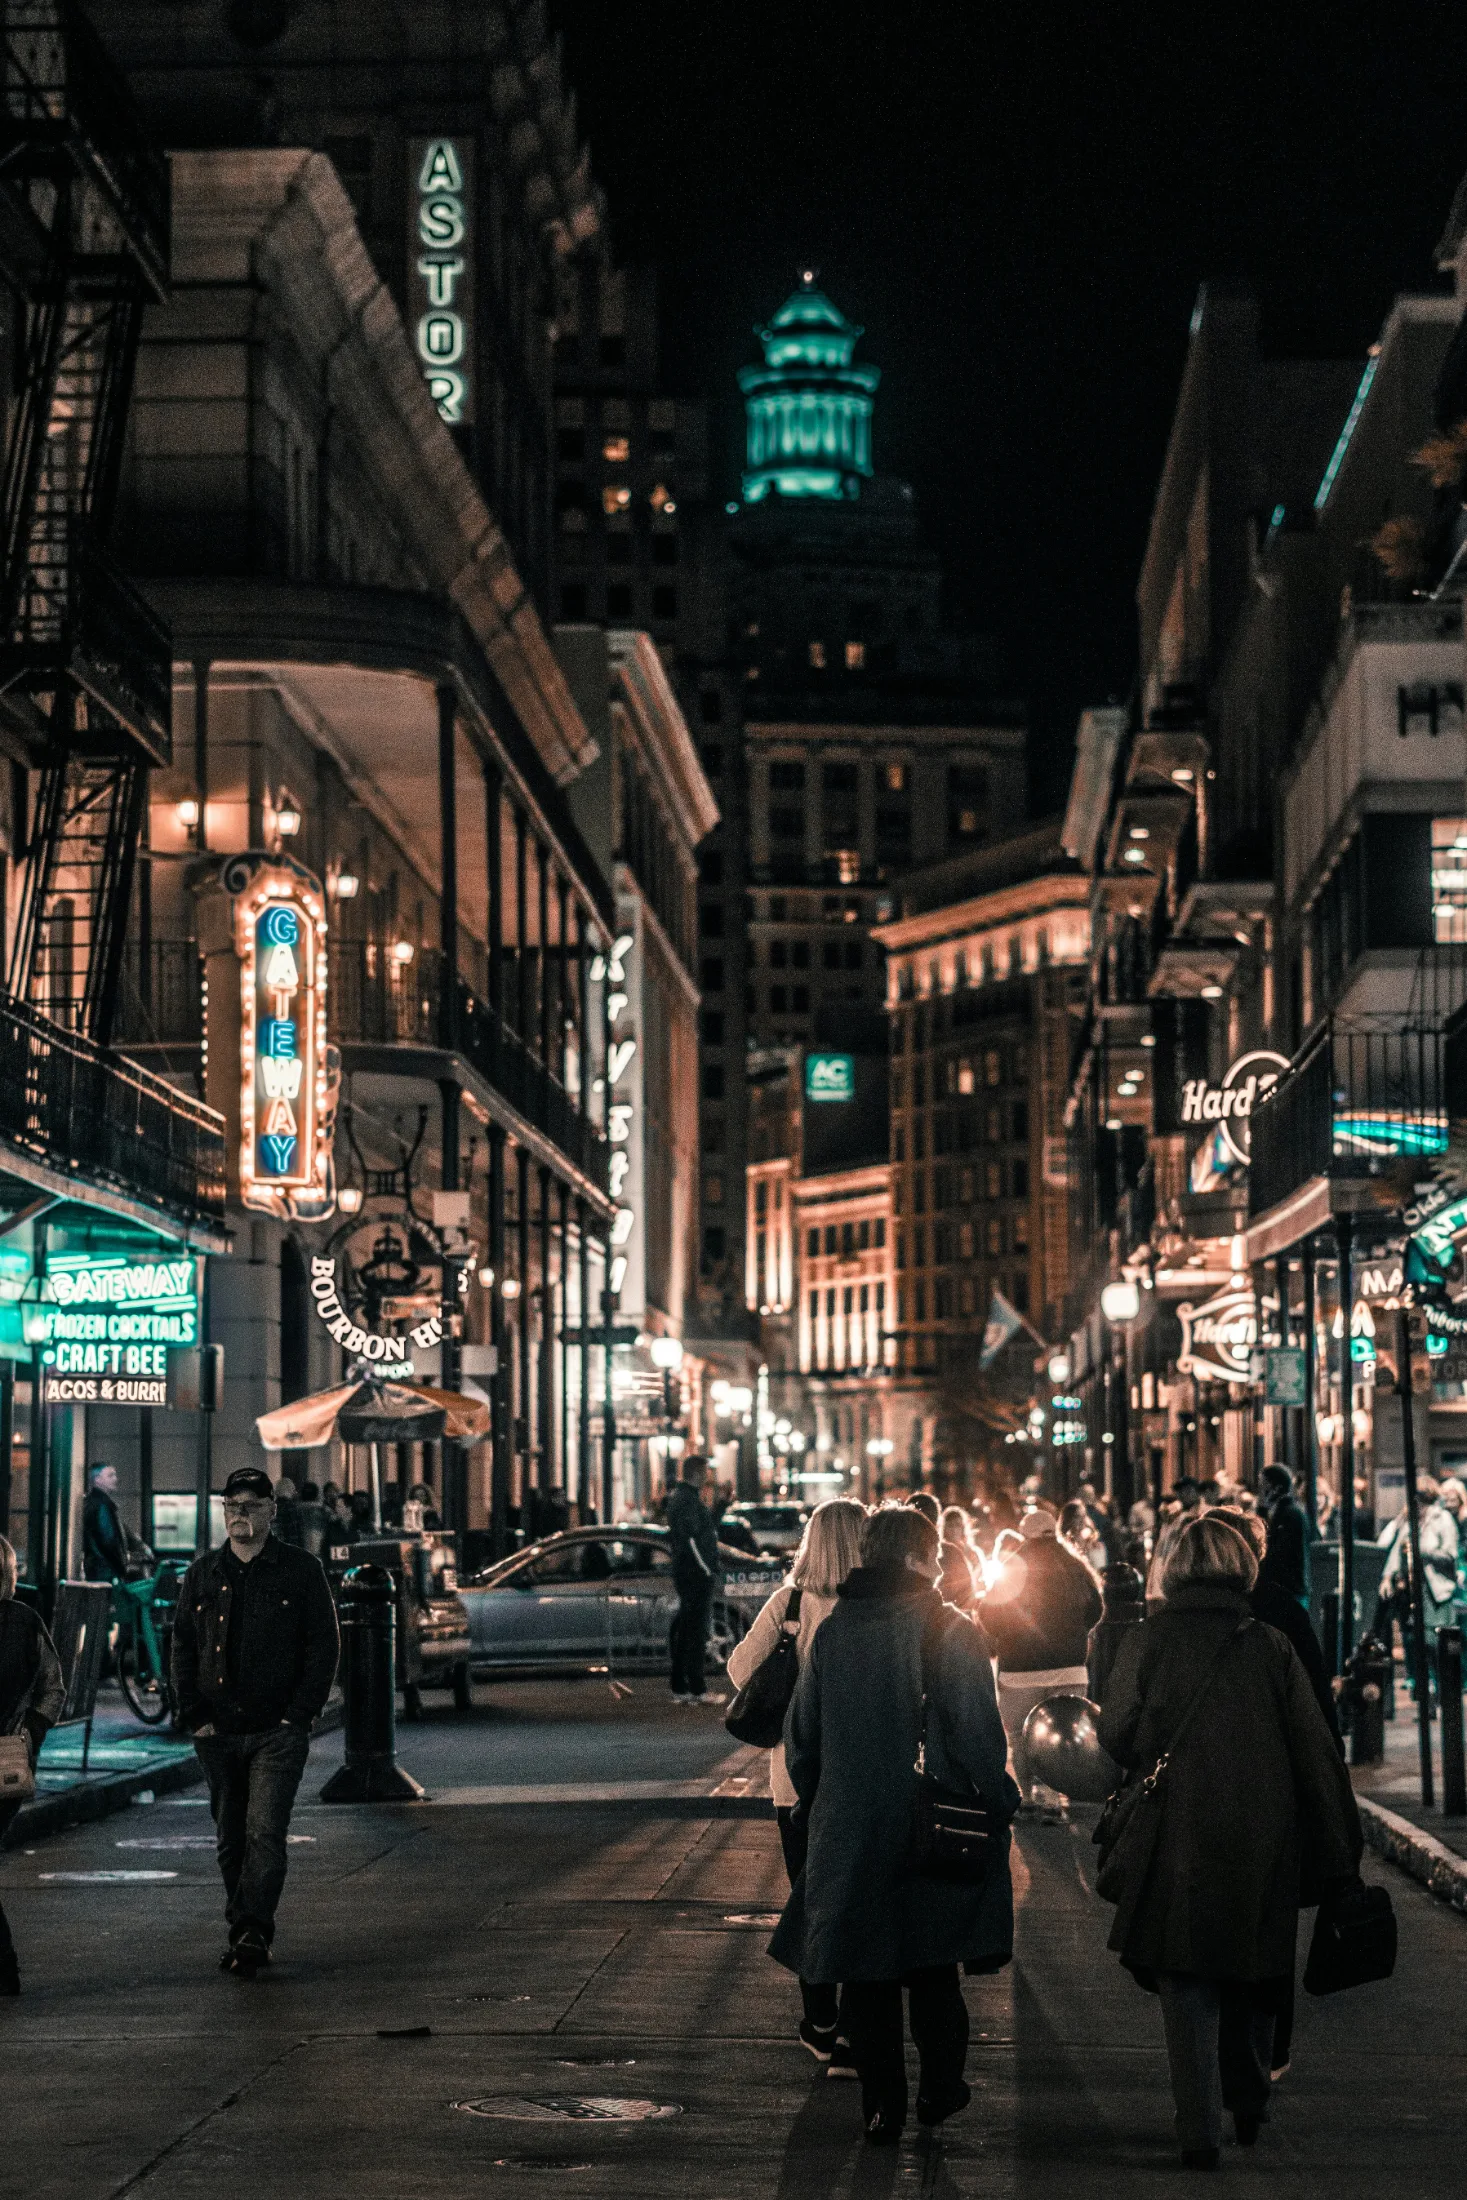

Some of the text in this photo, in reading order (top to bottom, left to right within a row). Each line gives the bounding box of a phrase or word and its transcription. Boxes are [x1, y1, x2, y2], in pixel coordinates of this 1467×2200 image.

[418, 140, 464, 422] ASTOR
[261, 907, 303, 1172] GATEWAY
[1182, 1075, 1257, 1121] Hard
[50, 1261, 193, 1306] GATEWAY
[46, 1312, 195, 1342] FROZEN COCKTAILS
[311, 1256, 407, 1362] BOURBON
[56, 1343, 123, 1374] CRAFT
[101, 1379, 118, 1400] &
